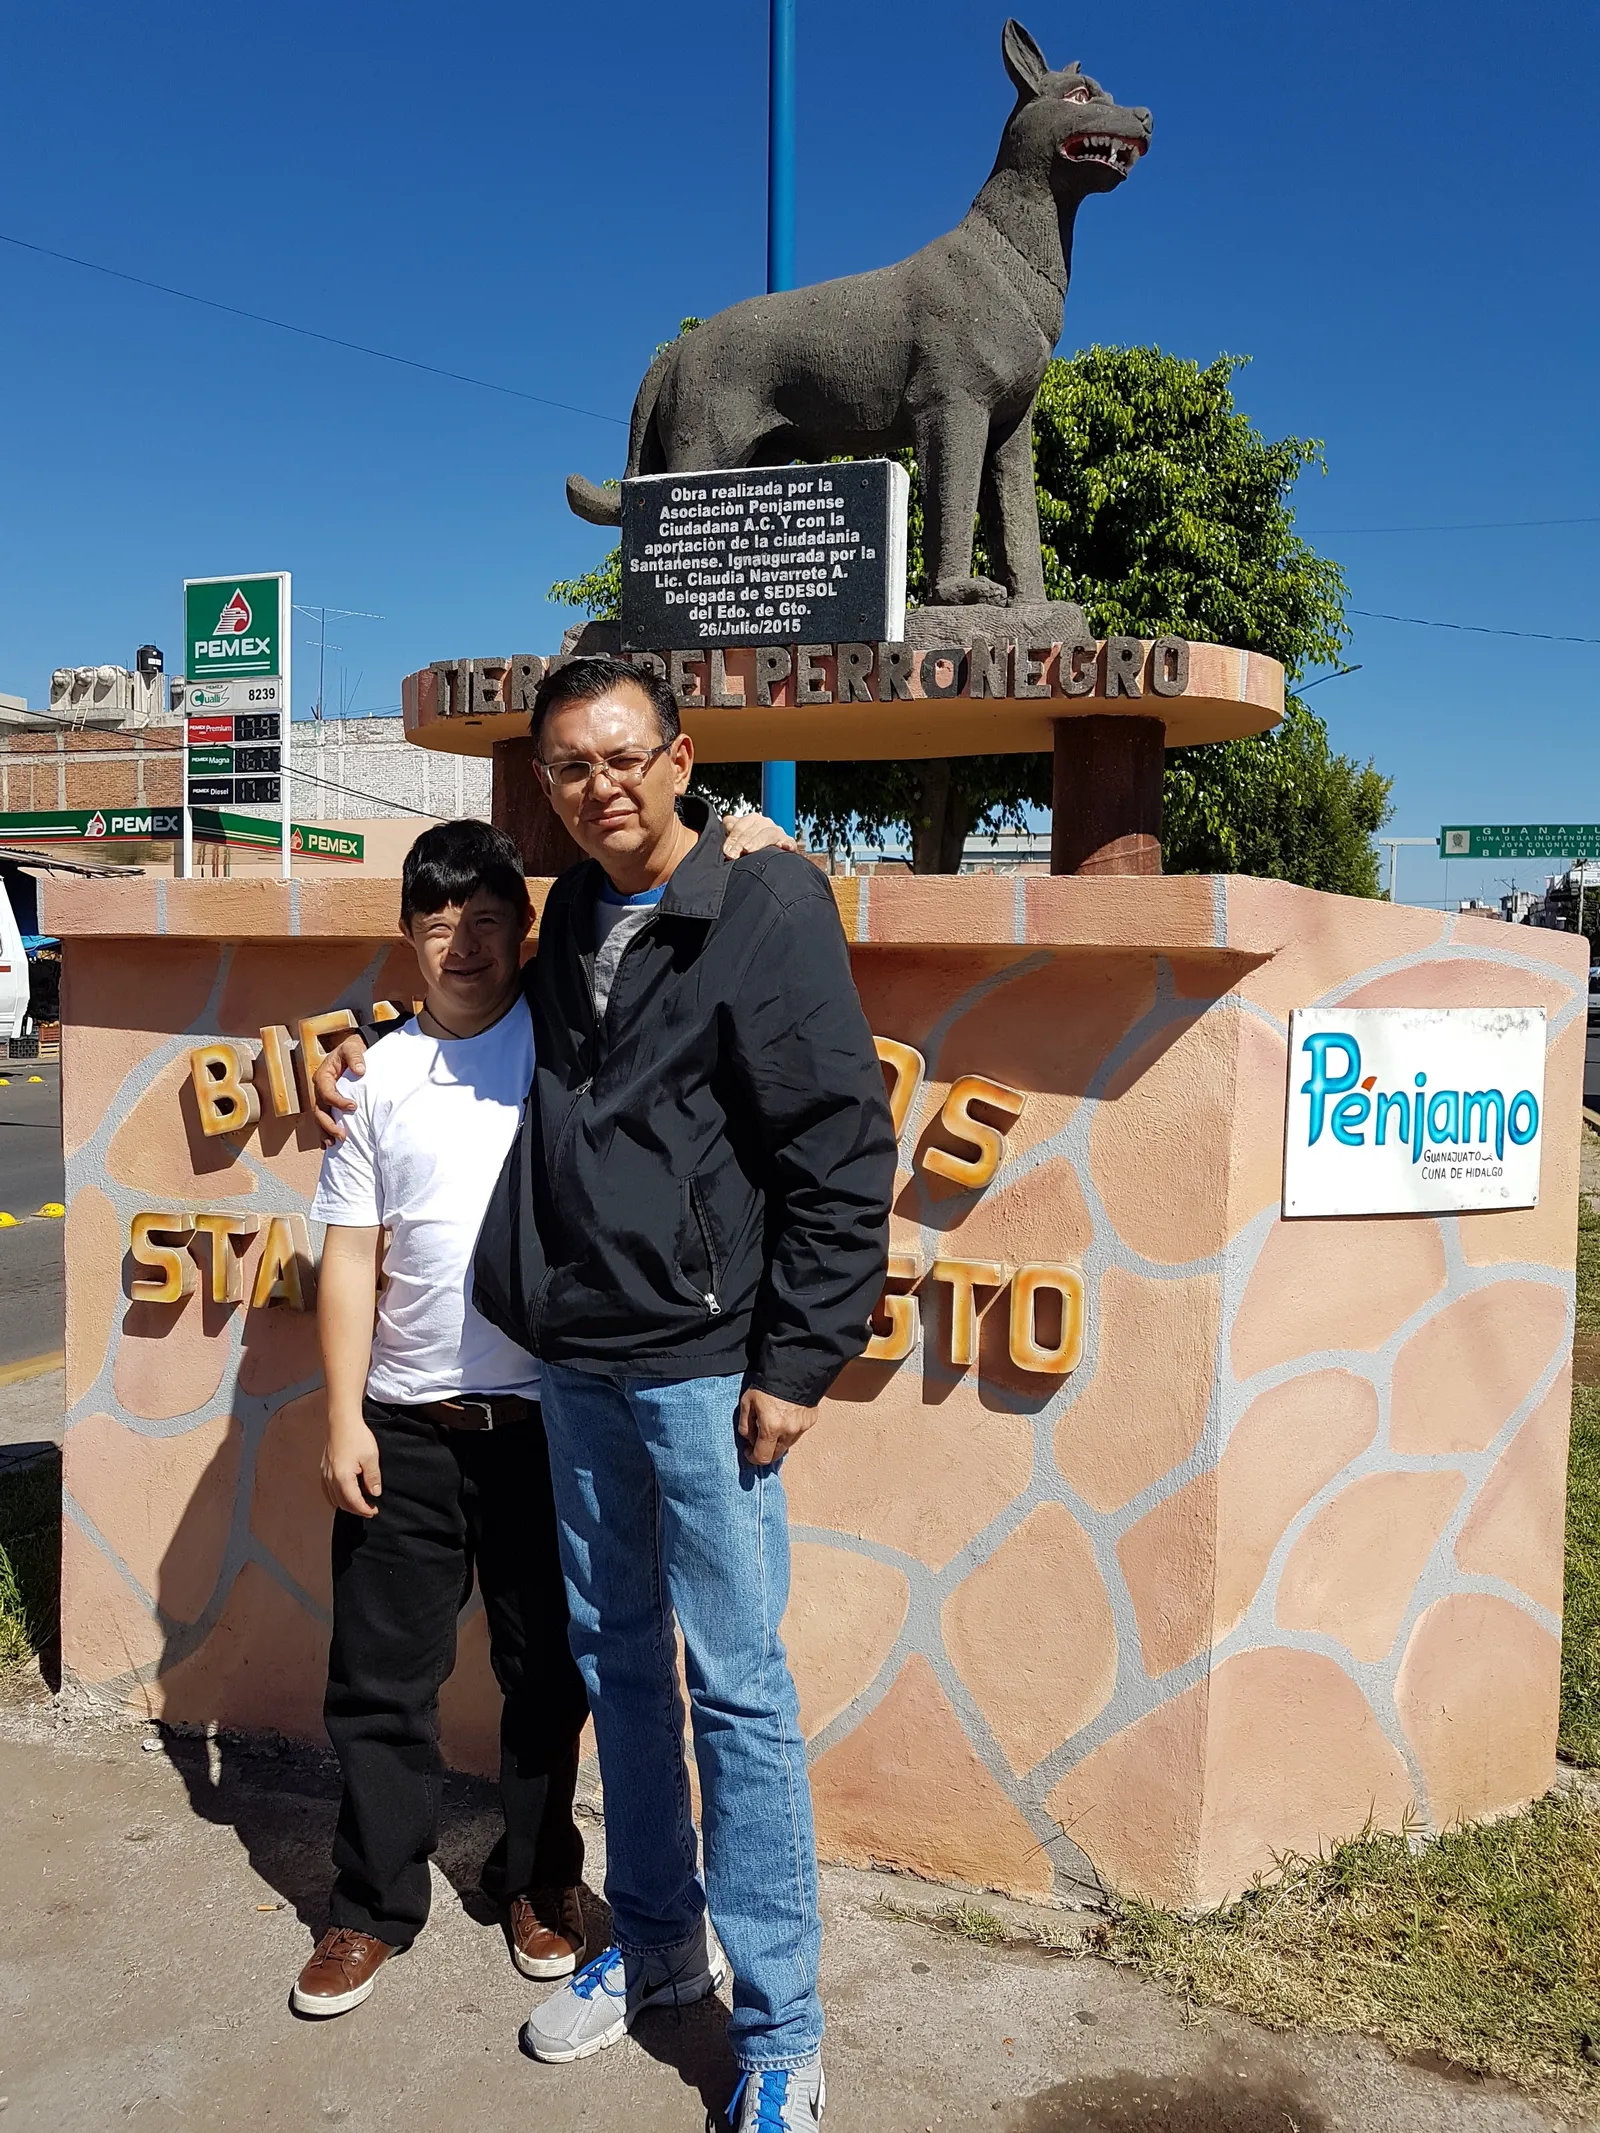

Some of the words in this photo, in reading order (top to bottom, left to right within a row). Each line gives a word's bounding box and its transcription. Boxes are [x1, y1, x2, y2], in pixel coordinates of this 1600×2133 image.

[671, 487, 707, 502] Obra
[712, 483, 782, 500] realizada
[788, 481, 812, 498] por
[818, 478, 832, 492] la
[750, 498, 844, 515] Penjamense
[659, 518, 739, 537] Ciudadana
[744, 518, 775, 532] A.C.
[782, 516, 792, 528] Y
[796, 516, 826, 528] con
[830, 512, 844, 526] la
[730, 535, 750, 550] de
[754, 534, 769, 548] la
[630, 555, 722, 572] Santanense.
[830, 549, 856, 564] por
[861, 546, 876, 560] la
[655, 574, 682, 588] Lic.
[688, 569, 744, 586] Claudia
[750, 566, 827, 583] Navarrete
[832, 564, 848, 579] A.
[666, 588, 735, 606] Delegada
[740, 586, 759, 600] de
[764, 582, 837, 598] SEDESOL
[689, 605, 712, 620] del
[718, 603, 750, 618] Edo.
[755, 602, 773, 617] de
[779, 601, 812, 615] Gto.
[700, 618, 801, 637] 26/Julio/2015
[194, 637, 271, 659] PEMEX
[248, 688, 275, 701] 8239
[209, 757, 230, 765] Magna
[210, 788, 229, 796] Diesel
[111, 815, 179, 833] PEMEX
[308, 834, 358, 856] PEMEX
[1300, 1032, 1539, 1164] Pénjamo
[1423, 1149, 1481, 1163] GUANAJUATO
[1421, 1166, 1446, 1180] CUNA
[1450, 1167, 1463, 1179] DE
[1466, 1166, 1503, 1179] HIDALGO
